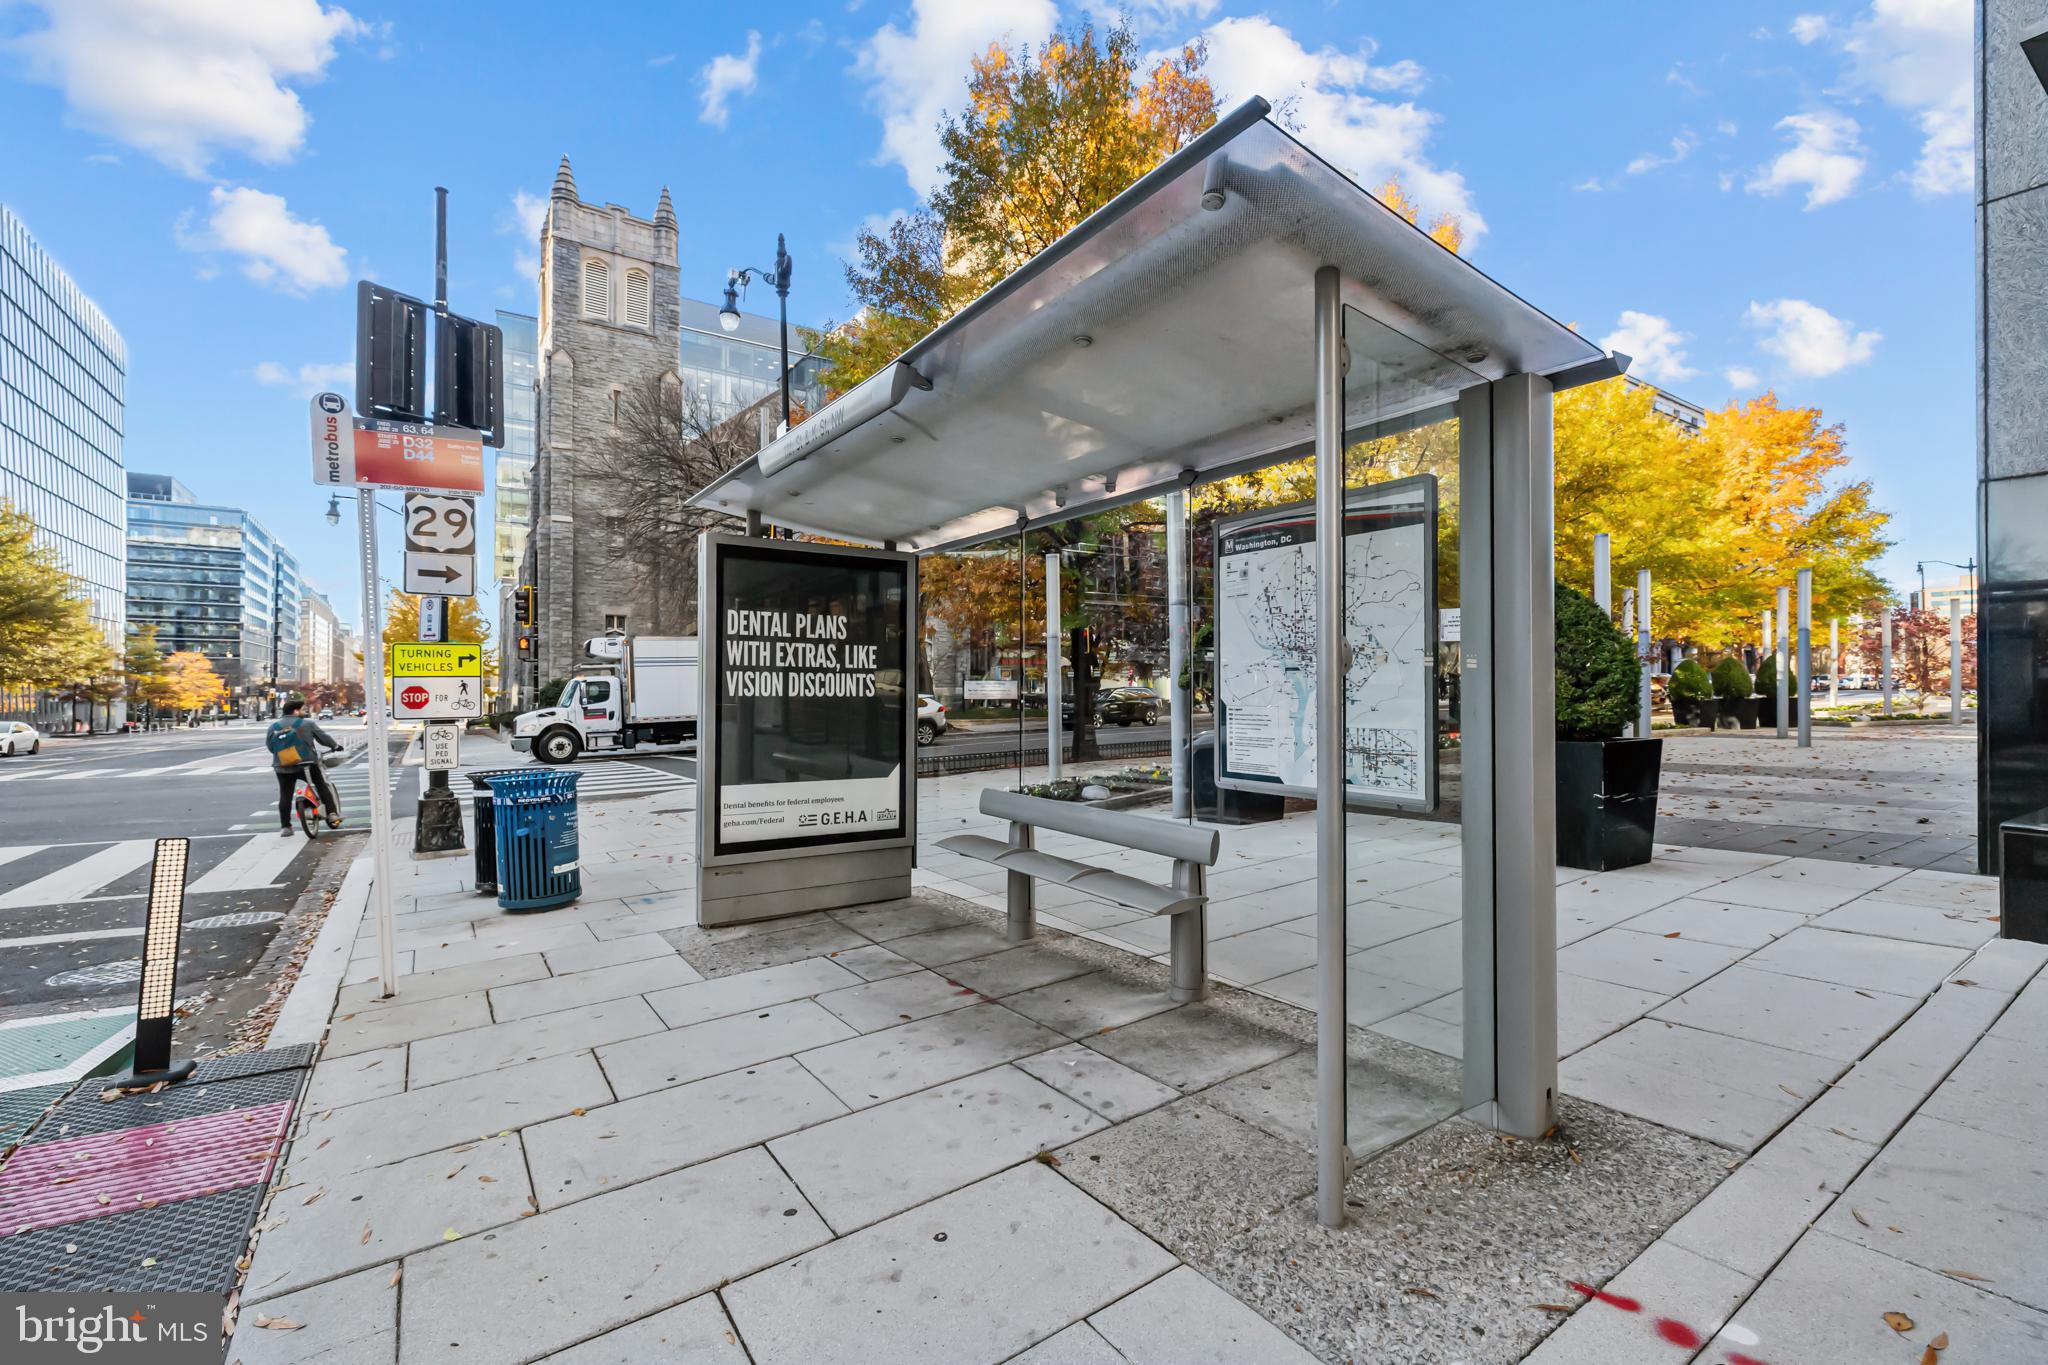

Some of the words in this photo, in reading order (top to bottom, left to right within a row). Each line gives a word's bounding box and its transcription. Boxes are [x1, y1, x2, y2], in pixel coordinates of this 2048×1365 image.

[421, 426, 434, 436] 64
[324, 416, 340, 483] metrobus
[402, 436, 433, 449] D32
[403, 448, 433, 462] D44
[412, 505, 468, 539] 29
[1235, 539, 1279, 552] Washington,
[1280, 535, 1292, 543] DC
[727, 609, 791, 638] DENTAL
[796, 613, 848, 640] PLANS
[400, 649, 452, 658] TURNING
[726, 640, 771, 667] WITH
[775, 641, 841, 672] EXTRAS,
[845, 645, 878, 669] LIKE
[398, 662, 453, 672] VEHICLES
[726, 671, 783, 697] VISION
[788, 672, 876, 697] DISCOUNTS
[402, 692, 428, 703] STOP
[435, 694, 448, 702] FOR
[723, 801, 747, 810] Dental
[747, 800, 775, 808] benefits
[776, 799, 786, 807] for
[787, 797, 810, 806] federal
[811, 796, 845, 806] employees
[723, 816, 785, 829] geha.com/Federal
[821, 810, 867, 826] G.E.H.A
